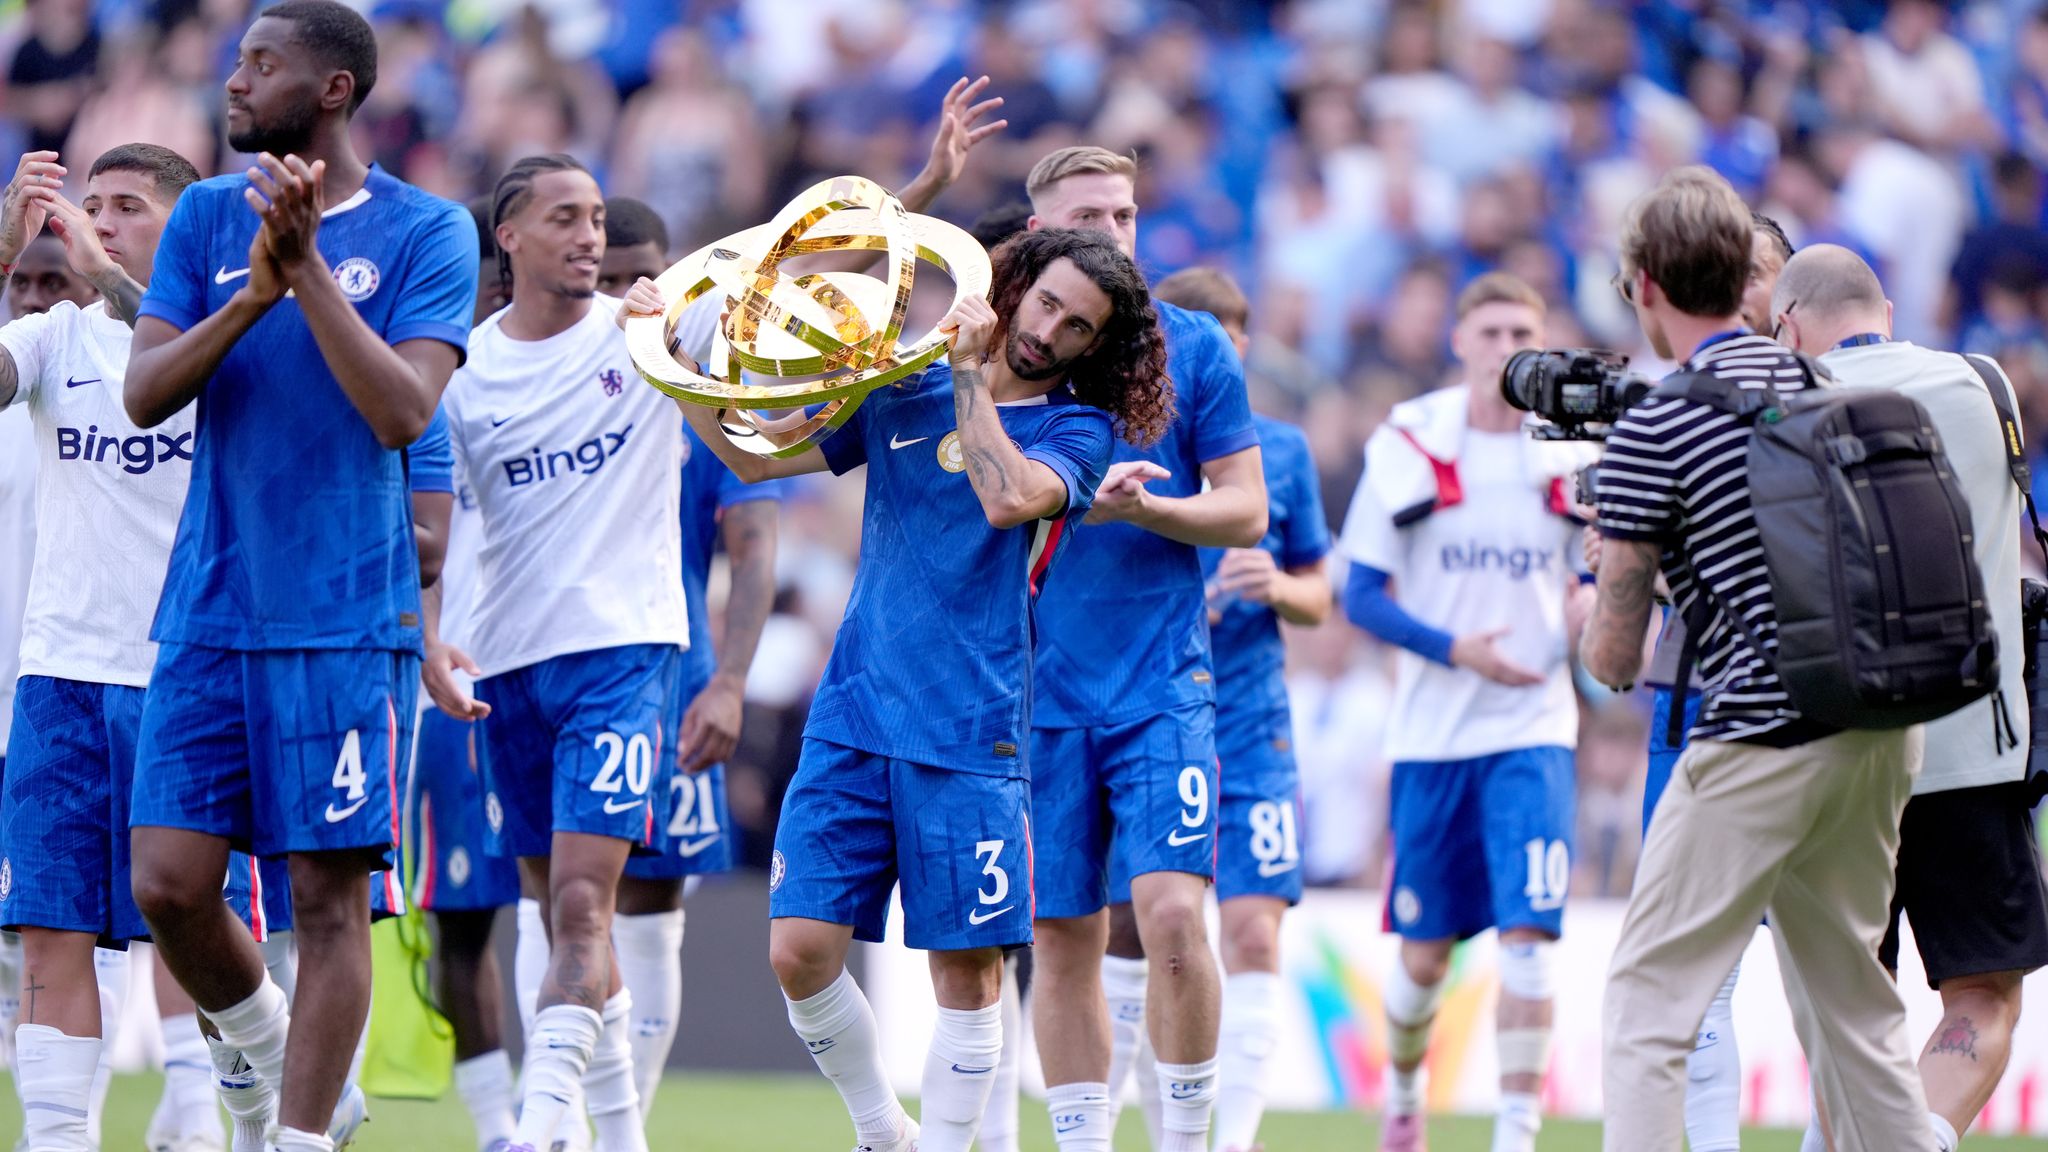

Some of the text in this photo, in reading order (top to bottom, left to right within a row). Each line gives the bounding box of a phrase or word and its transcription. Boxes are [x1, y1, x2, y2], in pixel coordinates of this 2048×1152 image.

[944, 460, 960, 471] FIFA
[332, 728, 367, 800] 4
[589, 731, 651, 795] 20
[667, 772, 720, 837] 21
[1178, 766, 1208, 828] 9
[1250, 800, 1299, 862] 81
[975, 839, 1008, 905] 3
[1524, 836, 1569, 898] 10
[808, 1037, 834, 1047] FC
[1697, 1031, 1718, 1041] FC
[1171, 1081, 1203, 1092] CFC
[1055, 1113, 1086, 1123] CFC
